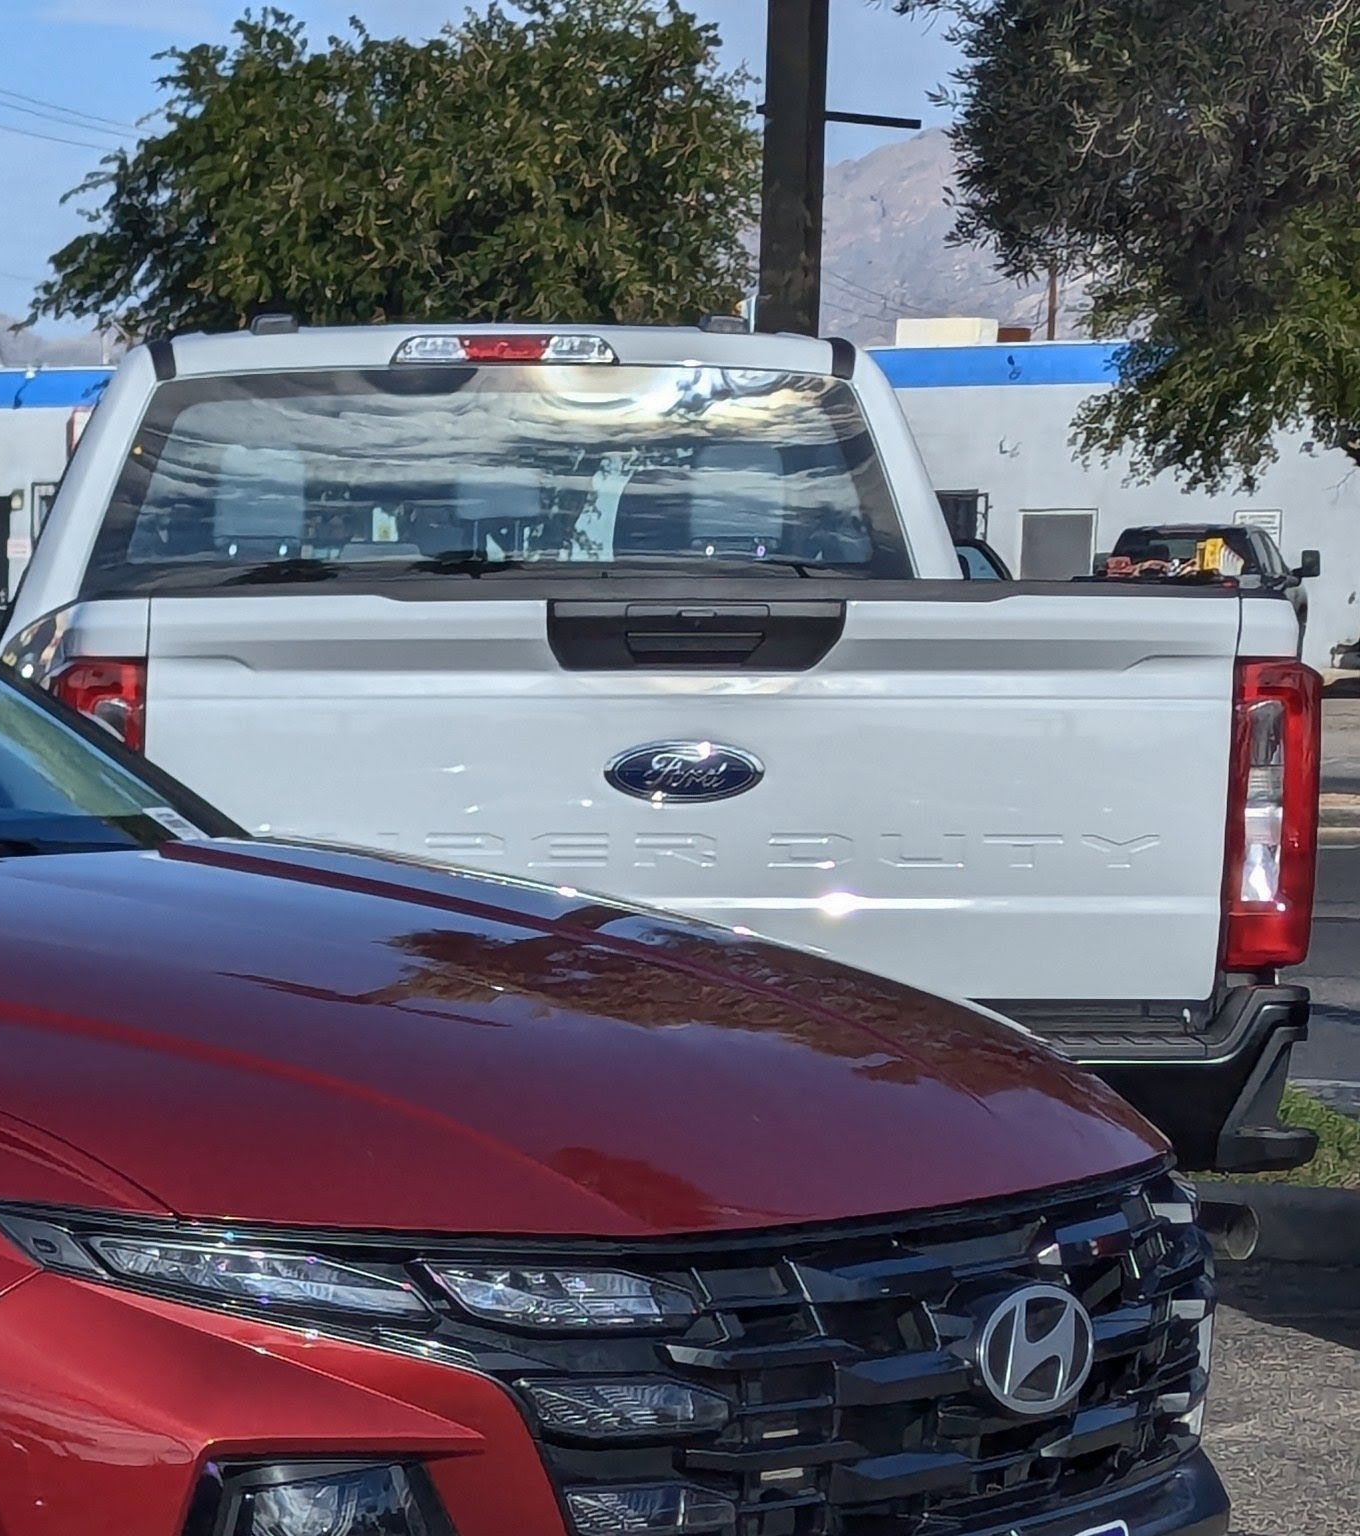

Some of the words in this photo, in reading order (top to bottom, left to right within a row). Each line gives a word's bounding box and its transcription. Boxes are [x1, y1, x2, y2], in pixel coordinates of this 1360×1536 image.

[642, 753, 728, 788] Ford
[316, 831, 718, 868] PER
[768, 832, 1161, 869] DUTY
